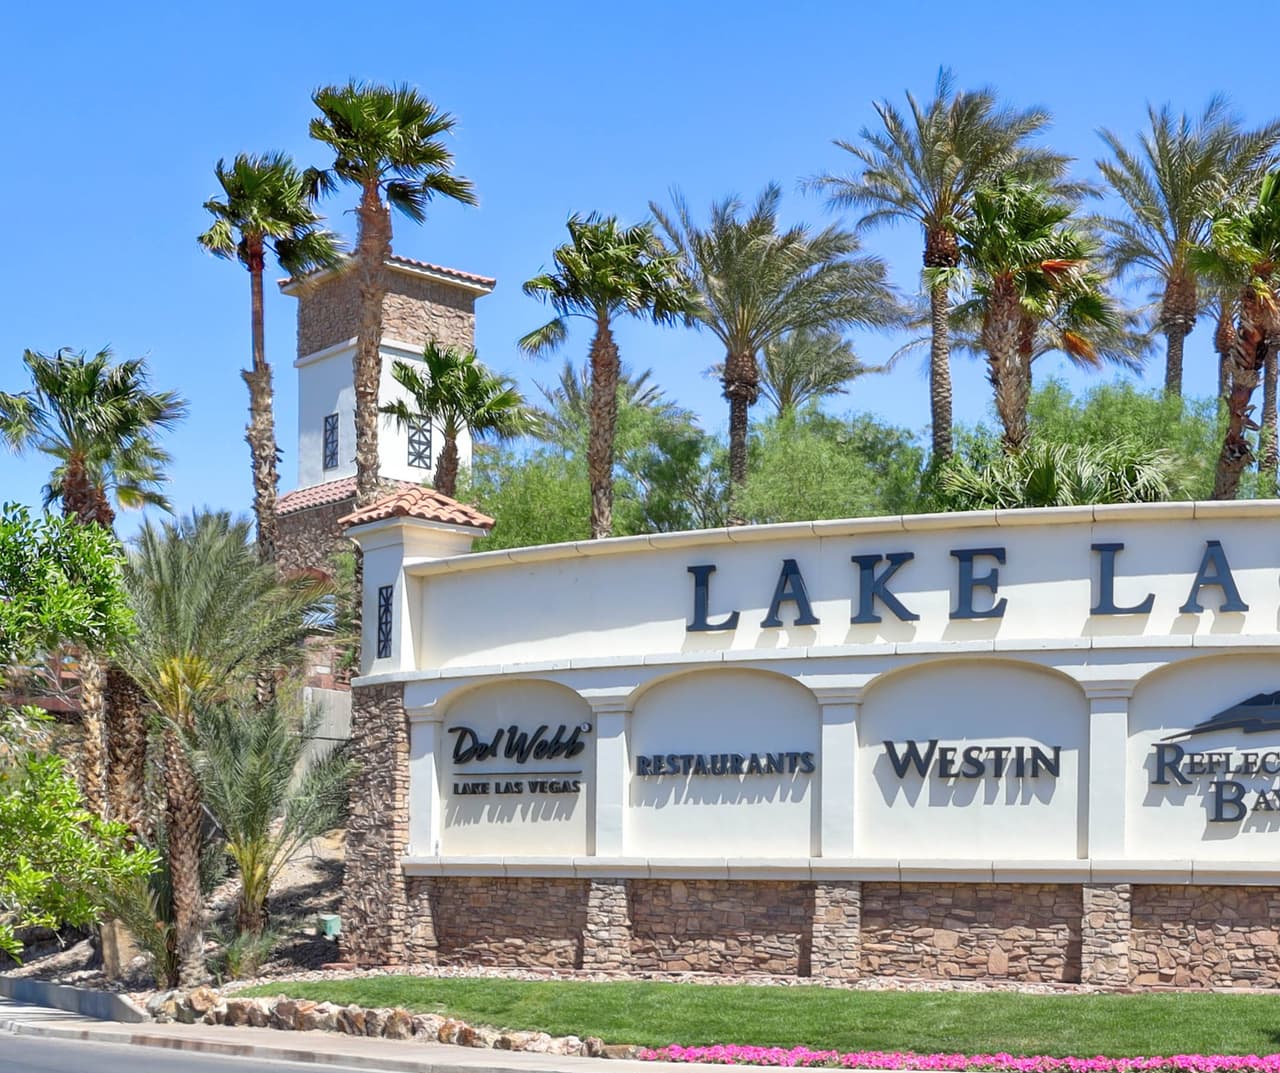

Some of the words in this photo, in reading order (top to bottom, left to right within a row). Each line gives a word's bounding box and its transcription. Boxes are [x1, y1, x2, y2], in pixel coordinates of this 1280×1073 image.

[686, 547, 1008, 632] LAKE
[448, 726, 504, 764] Del
[504, 724, 586, 764] Webb
[636, 751, 816, 776] RESTAURANTS
[882, 739, 1062, 779] WESTIN
[453, 781, 489, 795] LAKE
[495, 781, 523, 795] LAS
[528, 780, 581, 794] VEGAS
